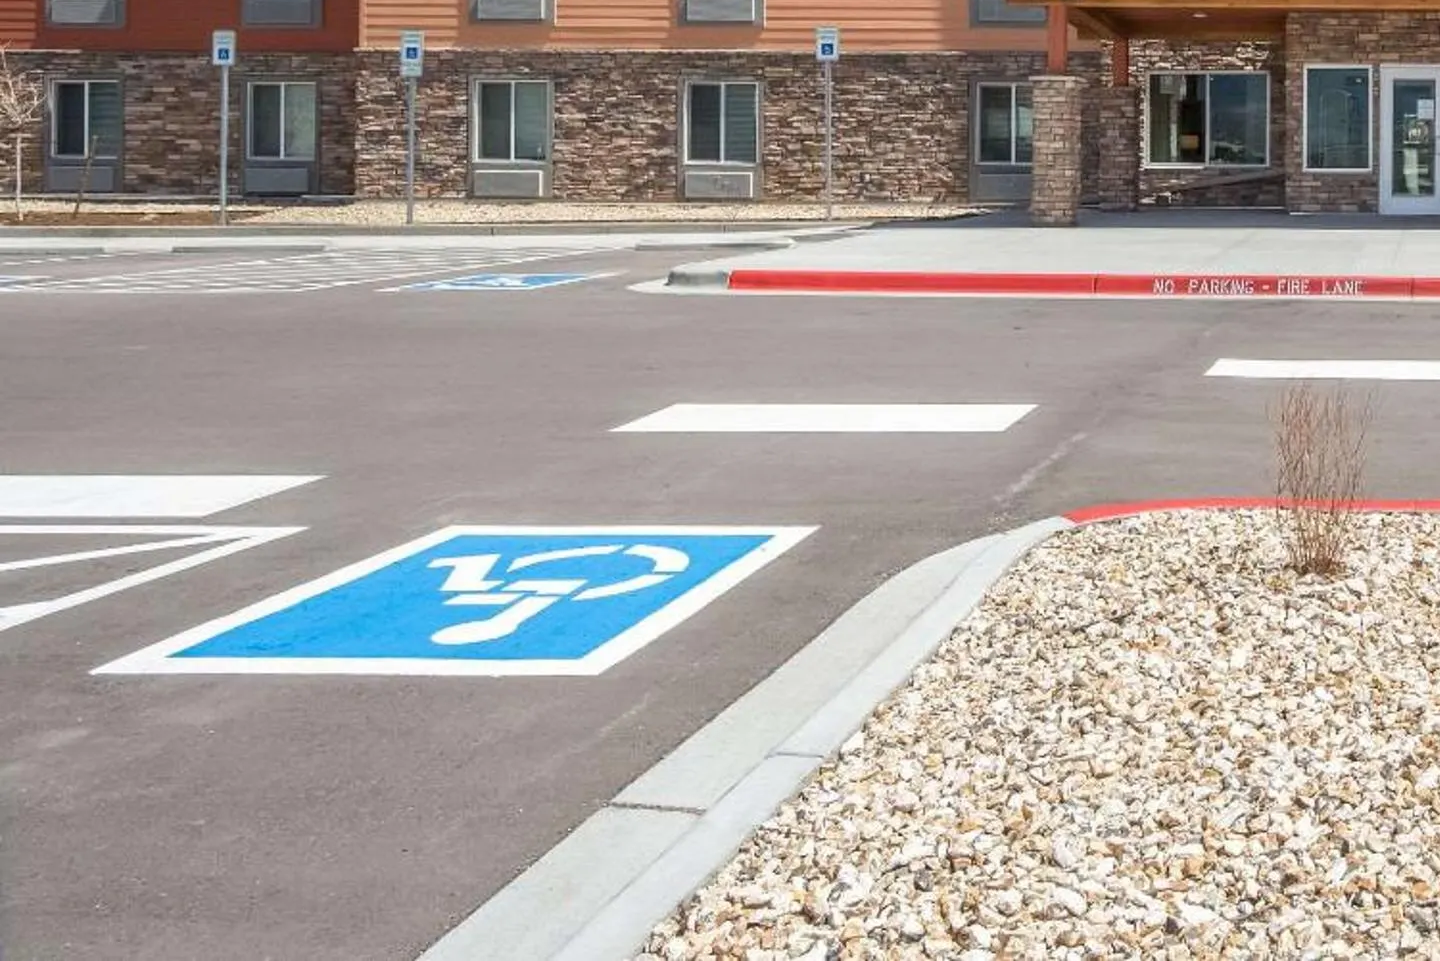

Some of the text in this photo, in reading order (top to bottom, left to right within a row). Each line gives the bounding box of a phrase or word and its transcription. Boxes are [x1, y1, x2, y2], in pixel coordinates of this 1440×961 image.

[1153, 278, 1175, 294] NO
[1187, 278, 1254, 294] PARKING
[1278, 278, 1310, 294] FIRE
[1322, 279, 1367, 295] LANE
